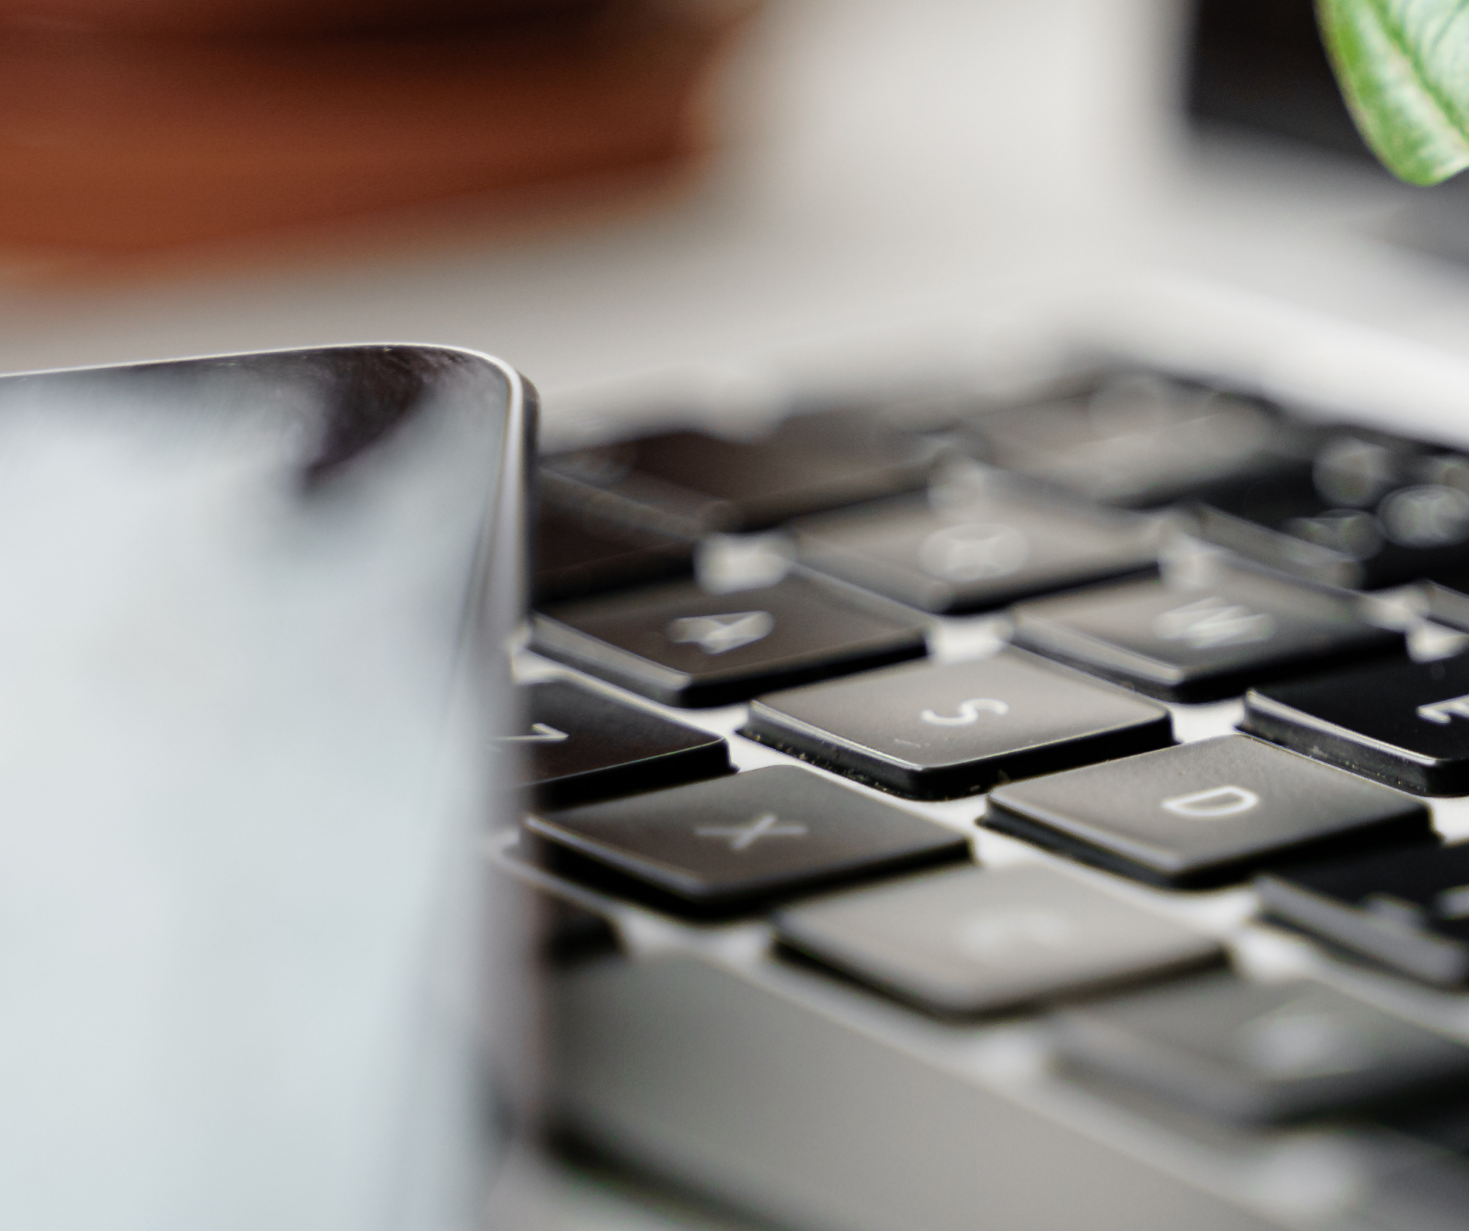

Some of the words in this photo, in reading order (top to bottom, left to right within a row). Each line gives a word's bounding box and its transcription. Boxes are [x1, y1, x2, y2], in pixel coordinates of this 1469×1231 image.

[919, 696, 1010, 727] S
[1160, 784, 1260, 818] D
[694, 813, 809, 850] X
